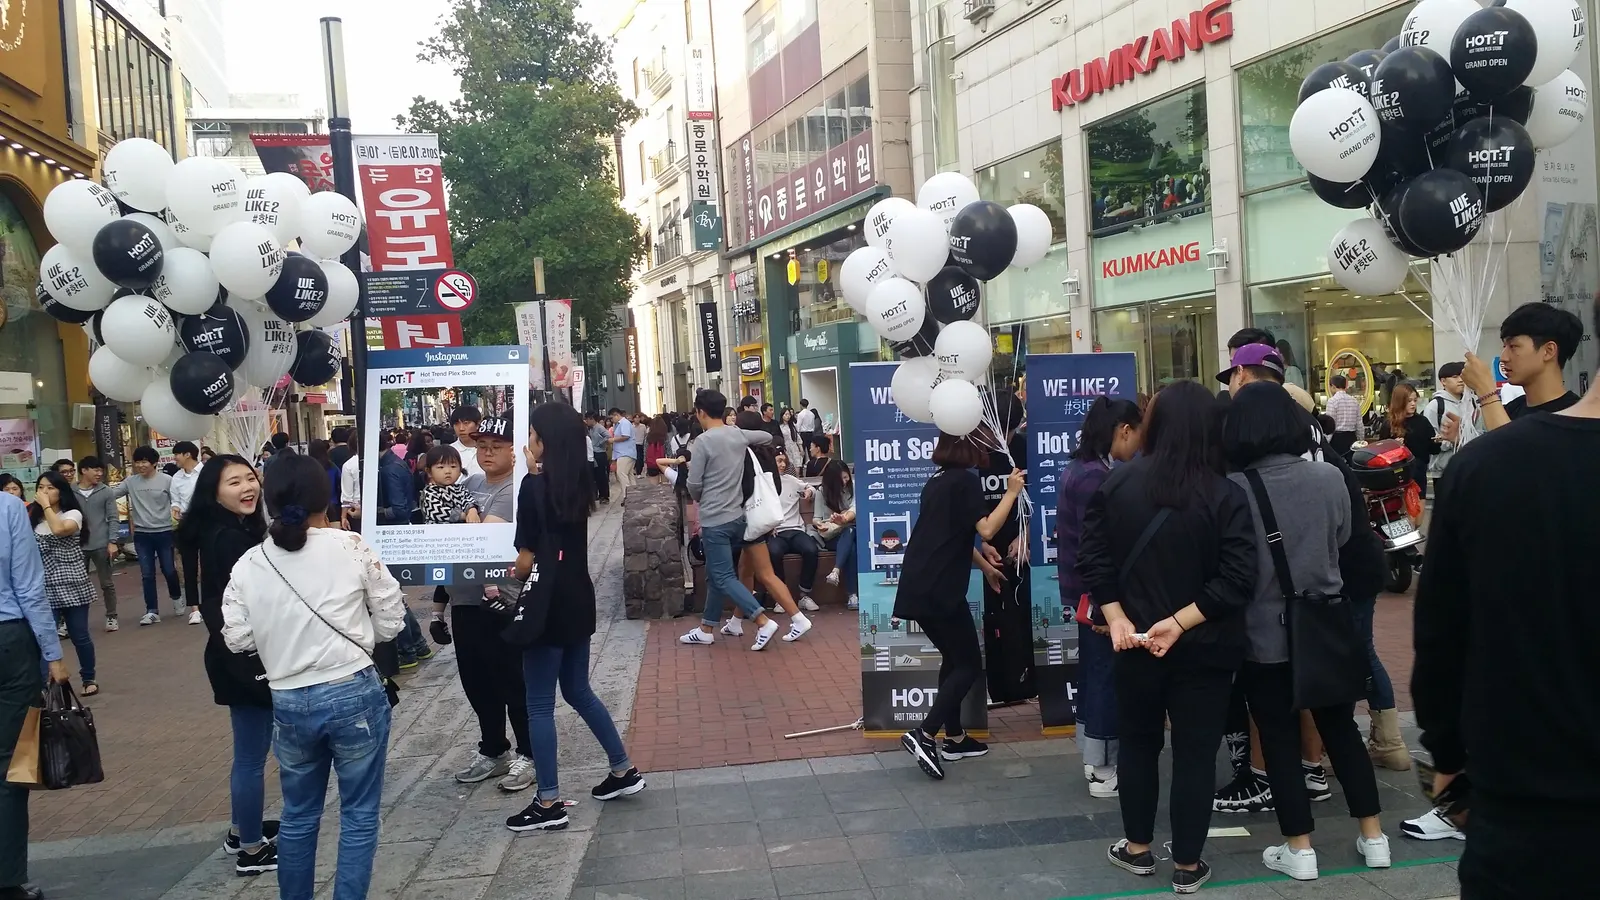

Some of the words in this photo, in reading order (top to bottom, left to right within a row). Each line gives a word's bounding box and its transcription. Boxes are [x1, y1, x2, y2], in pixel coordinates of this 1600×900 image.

[1465, 30, 1509, 49] HOT:T
[1051, 0, 1234, 112] KUMKANG
[1464, 60, 1488, 69] GRAND
[1489, 58, 1508, 67] OPEN
[1558, 108, 1577, 119] GRAND
[1329, 106, 1366, 140] HOT:T
[1339, 141, 1362, 160] GRAND
[1362, 132, 1376, 146] OPEN
[1468, 145, 1515, 163] HOT:T
[692, 124, 711, 198] 종로유학원
[776, 143, 871, 221] 종로유학원
[1494, 175, 1513, 183] OPEN
[246, 189, 266, 200] WE
[1449, 192, 1471, 215] WE
[929, 196, 957, 212] HOT:T
[252, 213, 278, 226] #핫티
[331, 212, 358, 226] HOT:T
[872, 212, 887, 227] WE
[326, 229, 343, 238] GRAND
[127, 232, 155, 259] HOT:T
[257, 240, 274, 256] WE
[1333, 238, 1350, 260] WE
[138, 258, 154, 273] GRAND
[1102, 241, 1200, 279] KUMKANG
[1353, 249, 1378, 275] #핫티
[47, 262, 64, 279] WE
[865, 258, 889, 282] HOT:T
[64, 277, 89, 297] #핫티
[297, 277, 315, 290] WE
[949, 283, 965, 299] WE
[143, 303, 159, 319] WE
[298, 301, 321, 312] #핫티
[881, 300, 908, 320] HOT:T
[264, 320, 281, 330] WE
[903, 317, 915, 327] OPEN
[192, 327, 225, 345] HOT:T
[705, 312, 717, 360] BEANPOLE
[216, 347, 231, 356] OPEN
[424, 351, 469, 364] Instagram
[627, 335, 637, 373] BEANPOLE
[203, 373, 228, 396] HOT:T
[380, 371, 416, 385] HOT:T
[1042, 378, 1068, 397] WE
[1072, 377, 1106, 396] LIKE
[1108, 376, 1120, 395] 2
[103, 415, 112, 449] SKINFOOD
[865, 438, 901, 461] Hot
[1037, 431, 1070, 455] Hot
[893, 712, 906, 721] HOT
[906, 712, 923, 721] TREND
